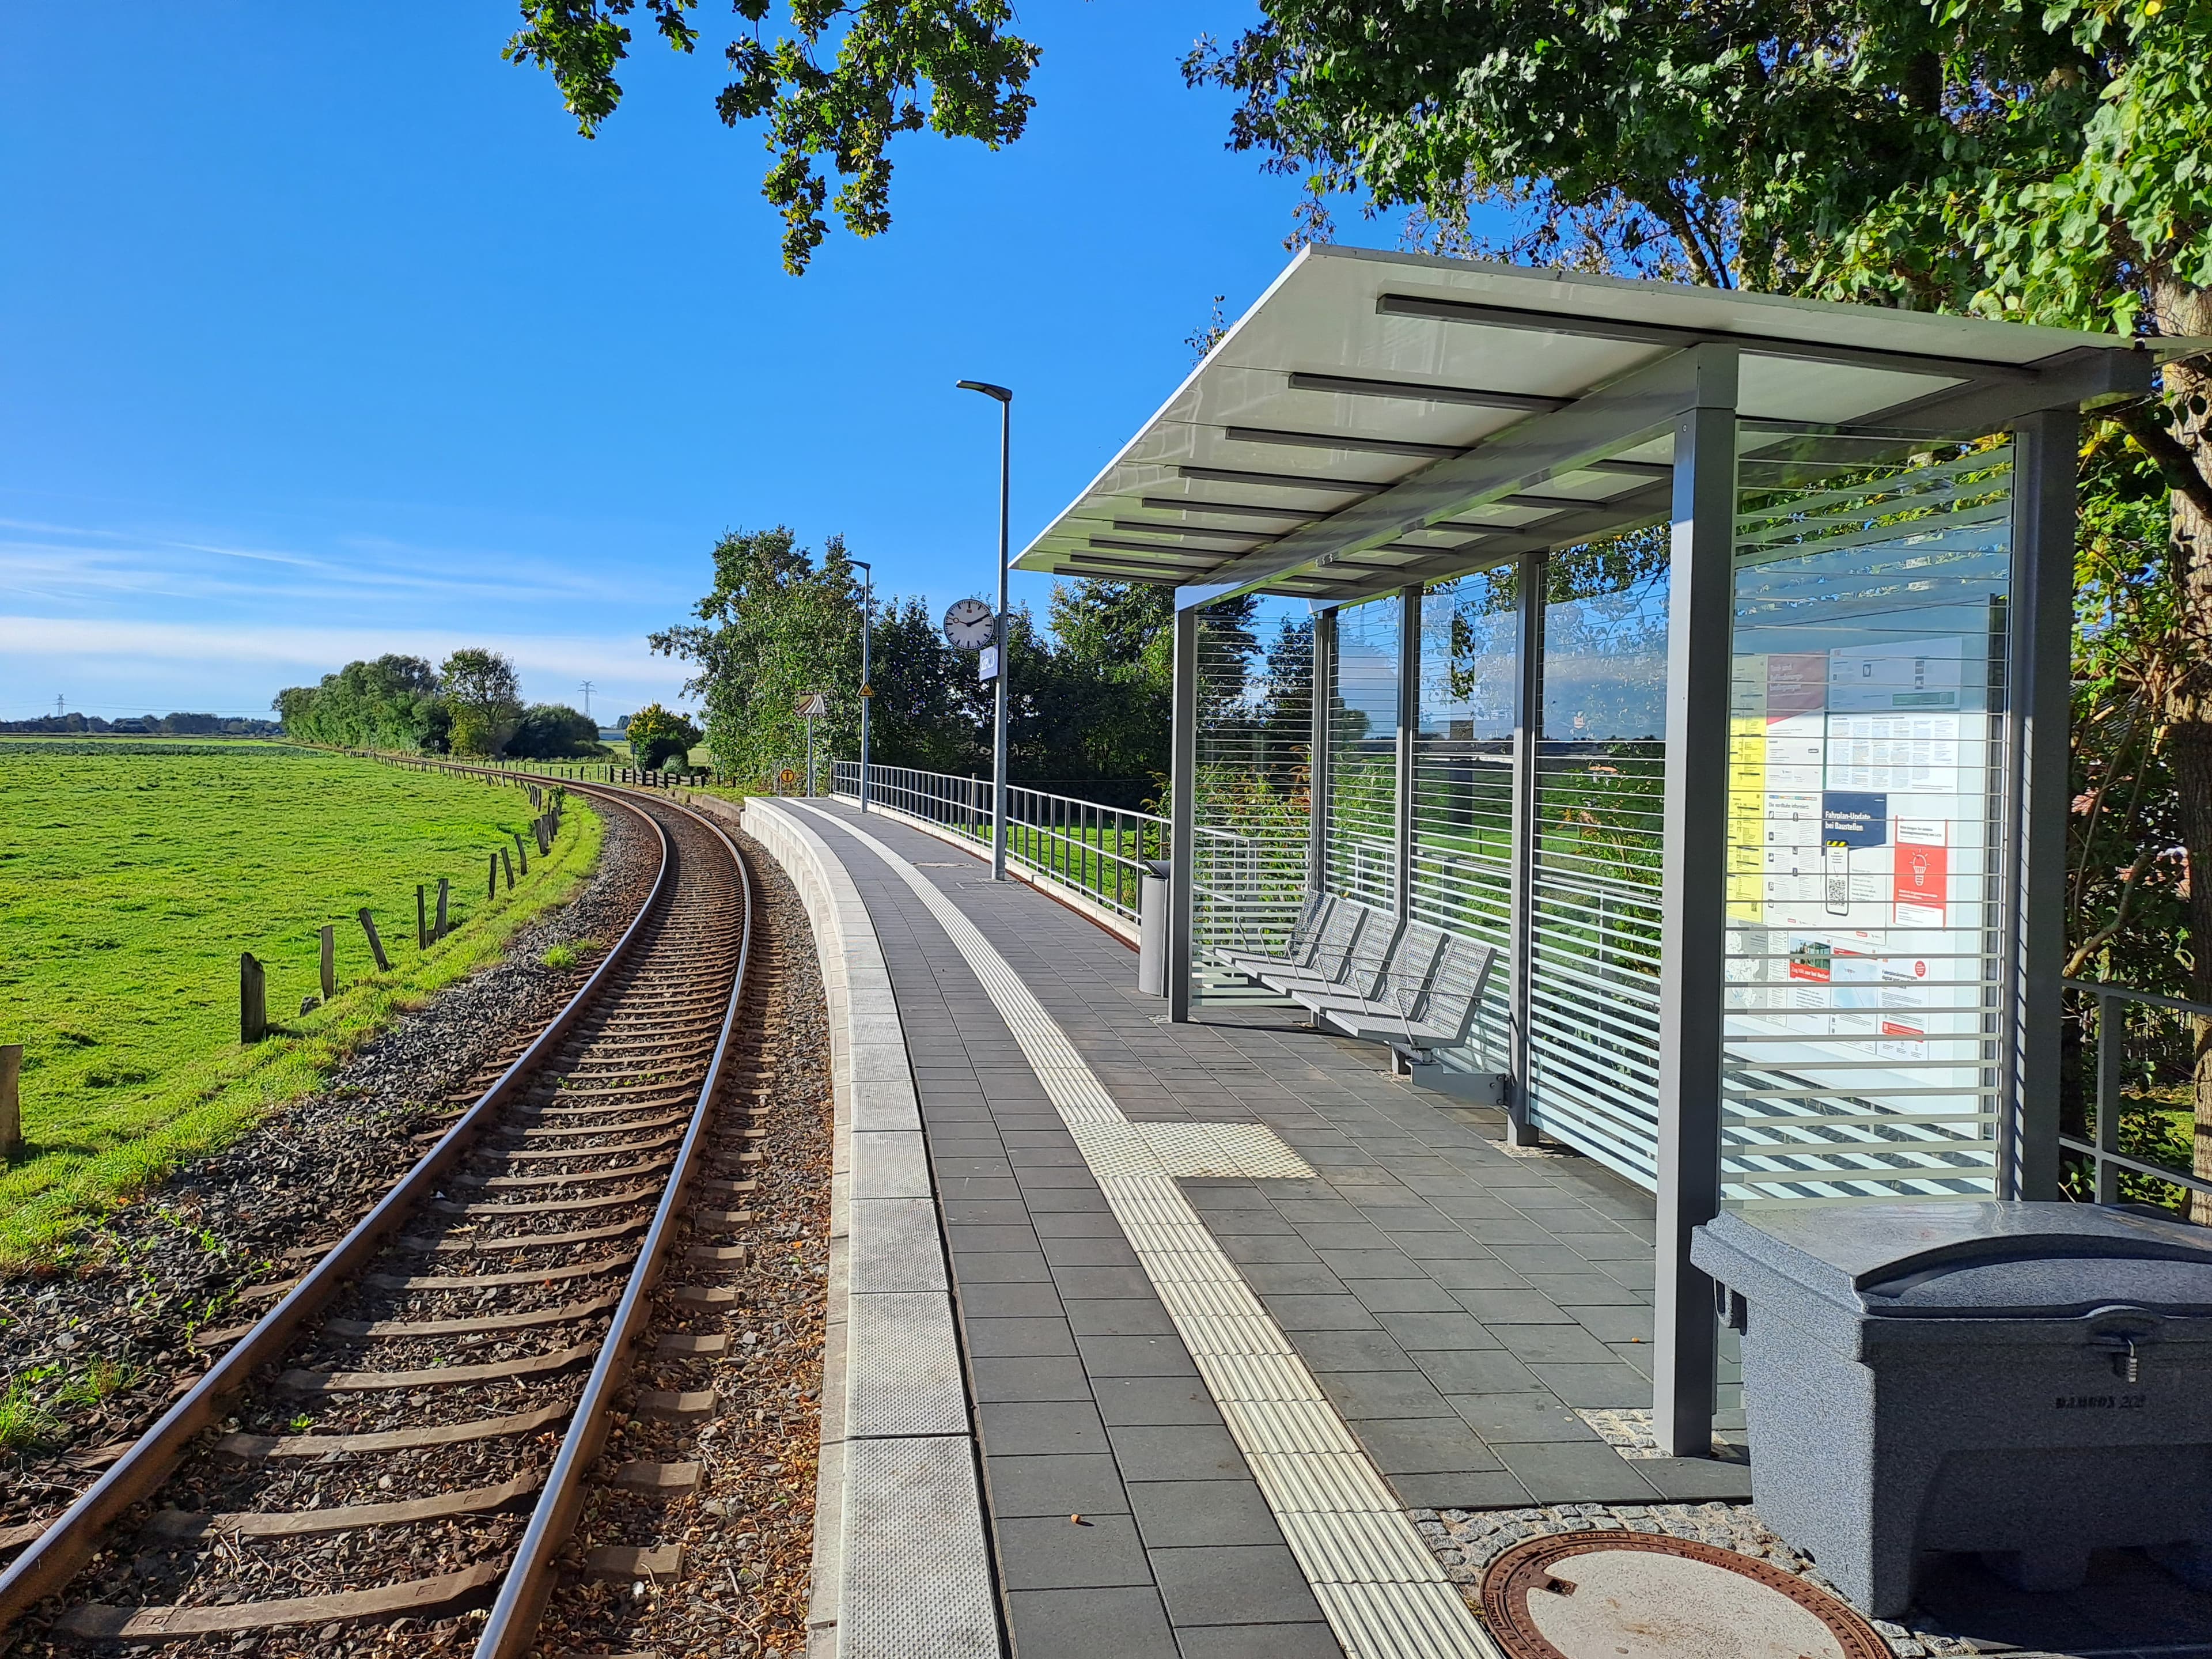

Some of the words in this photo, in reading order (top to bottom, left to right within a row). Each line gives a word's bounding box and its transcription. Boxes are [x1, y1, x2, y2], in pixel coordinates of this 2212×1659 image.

[1825, 810, 1870, 821] Fahrplan-Update
[1825, 821, 1834, 829] bei
[1835, 822, 1863, 831] Baustellen
